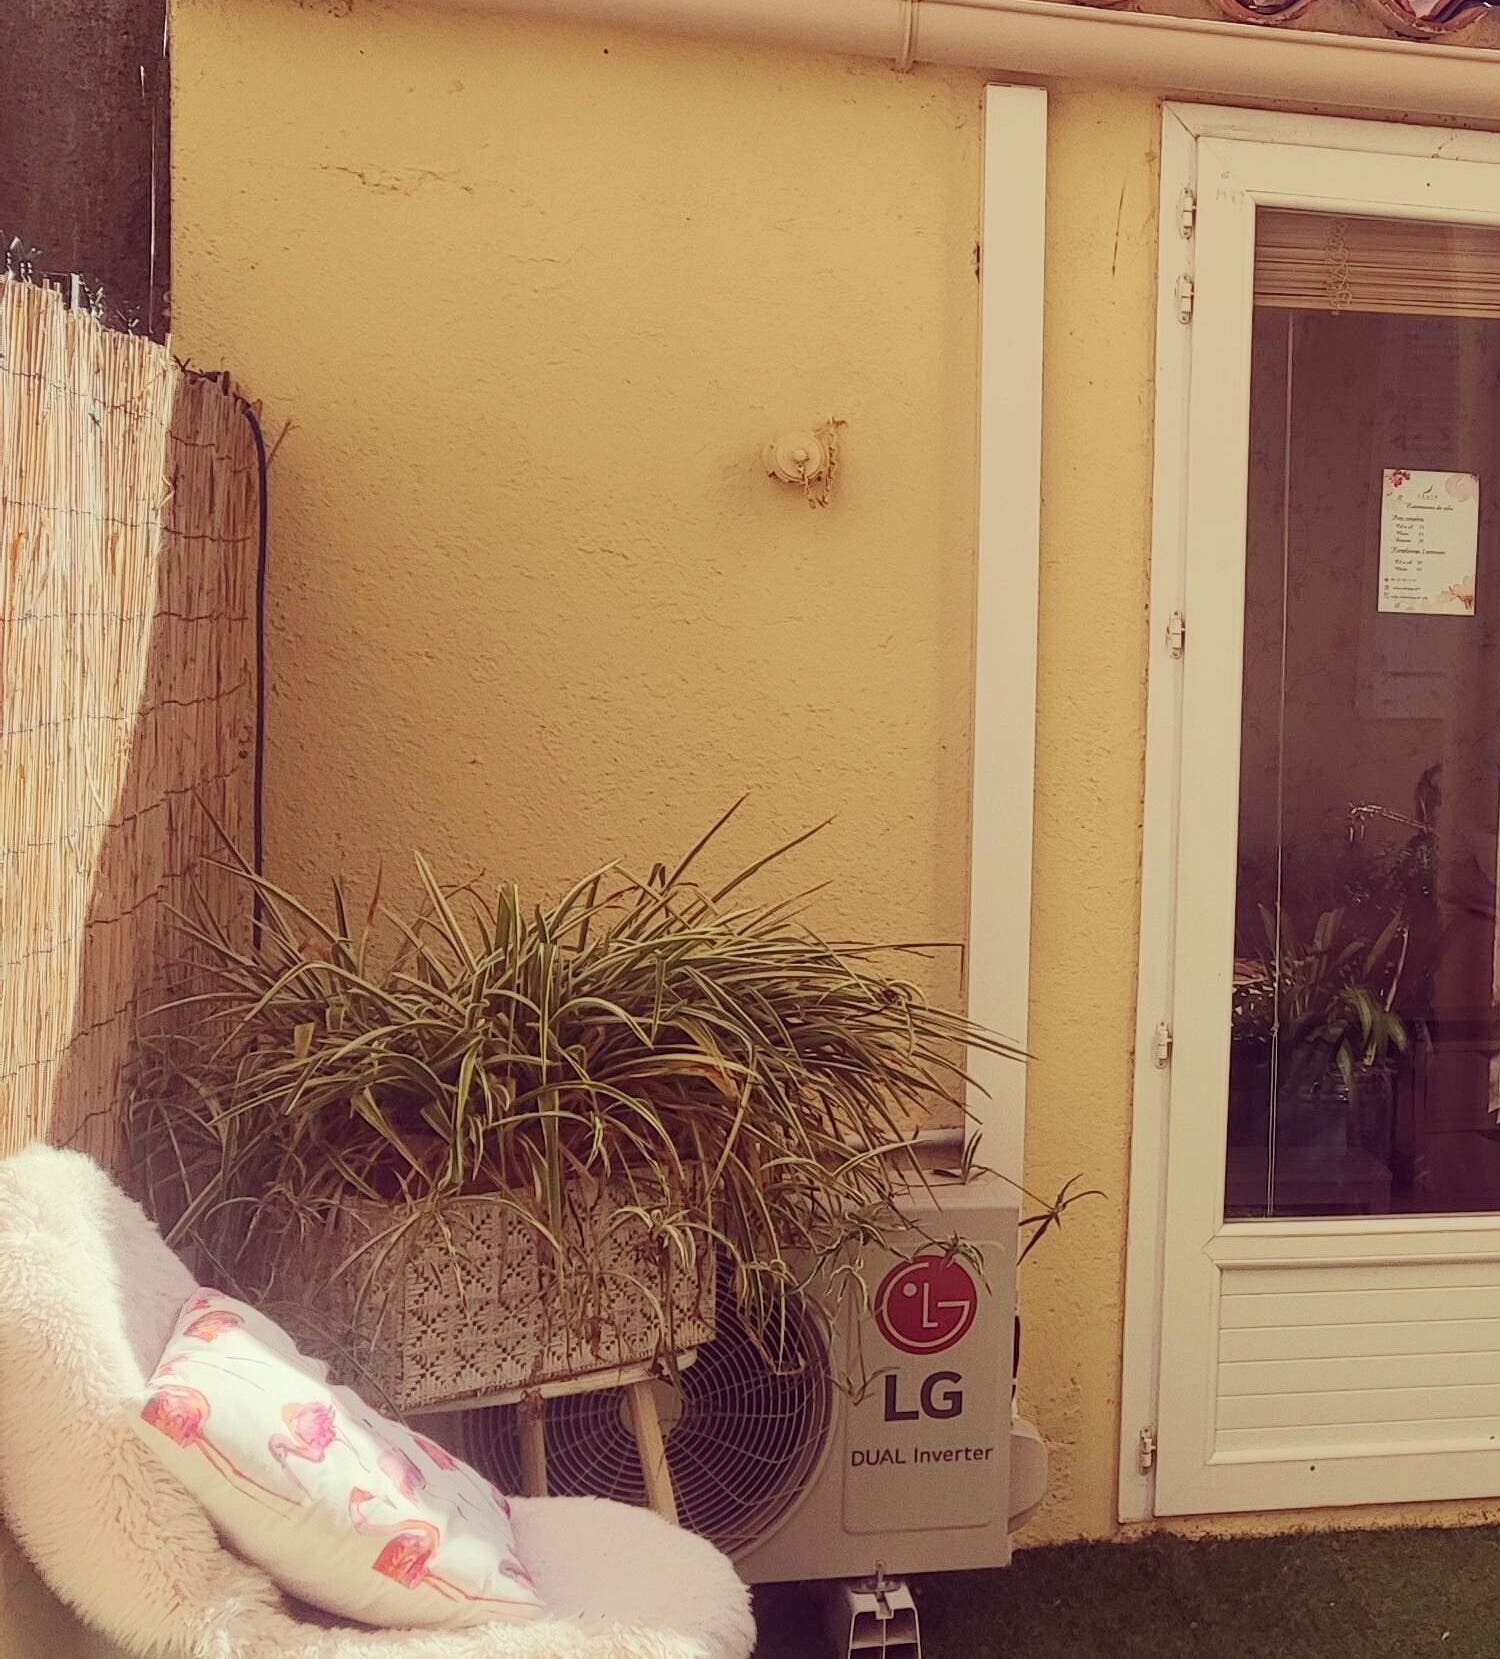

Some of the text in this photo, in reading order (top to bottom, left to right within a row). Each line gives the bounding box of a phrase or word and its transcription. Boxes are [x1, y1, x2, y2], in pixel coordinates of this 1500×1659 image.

[882, 1262, 971, 1348] LG
[884, 1371, 963, 1422] LG
[851, 1447, 993, 1467] DUAL Inverter
